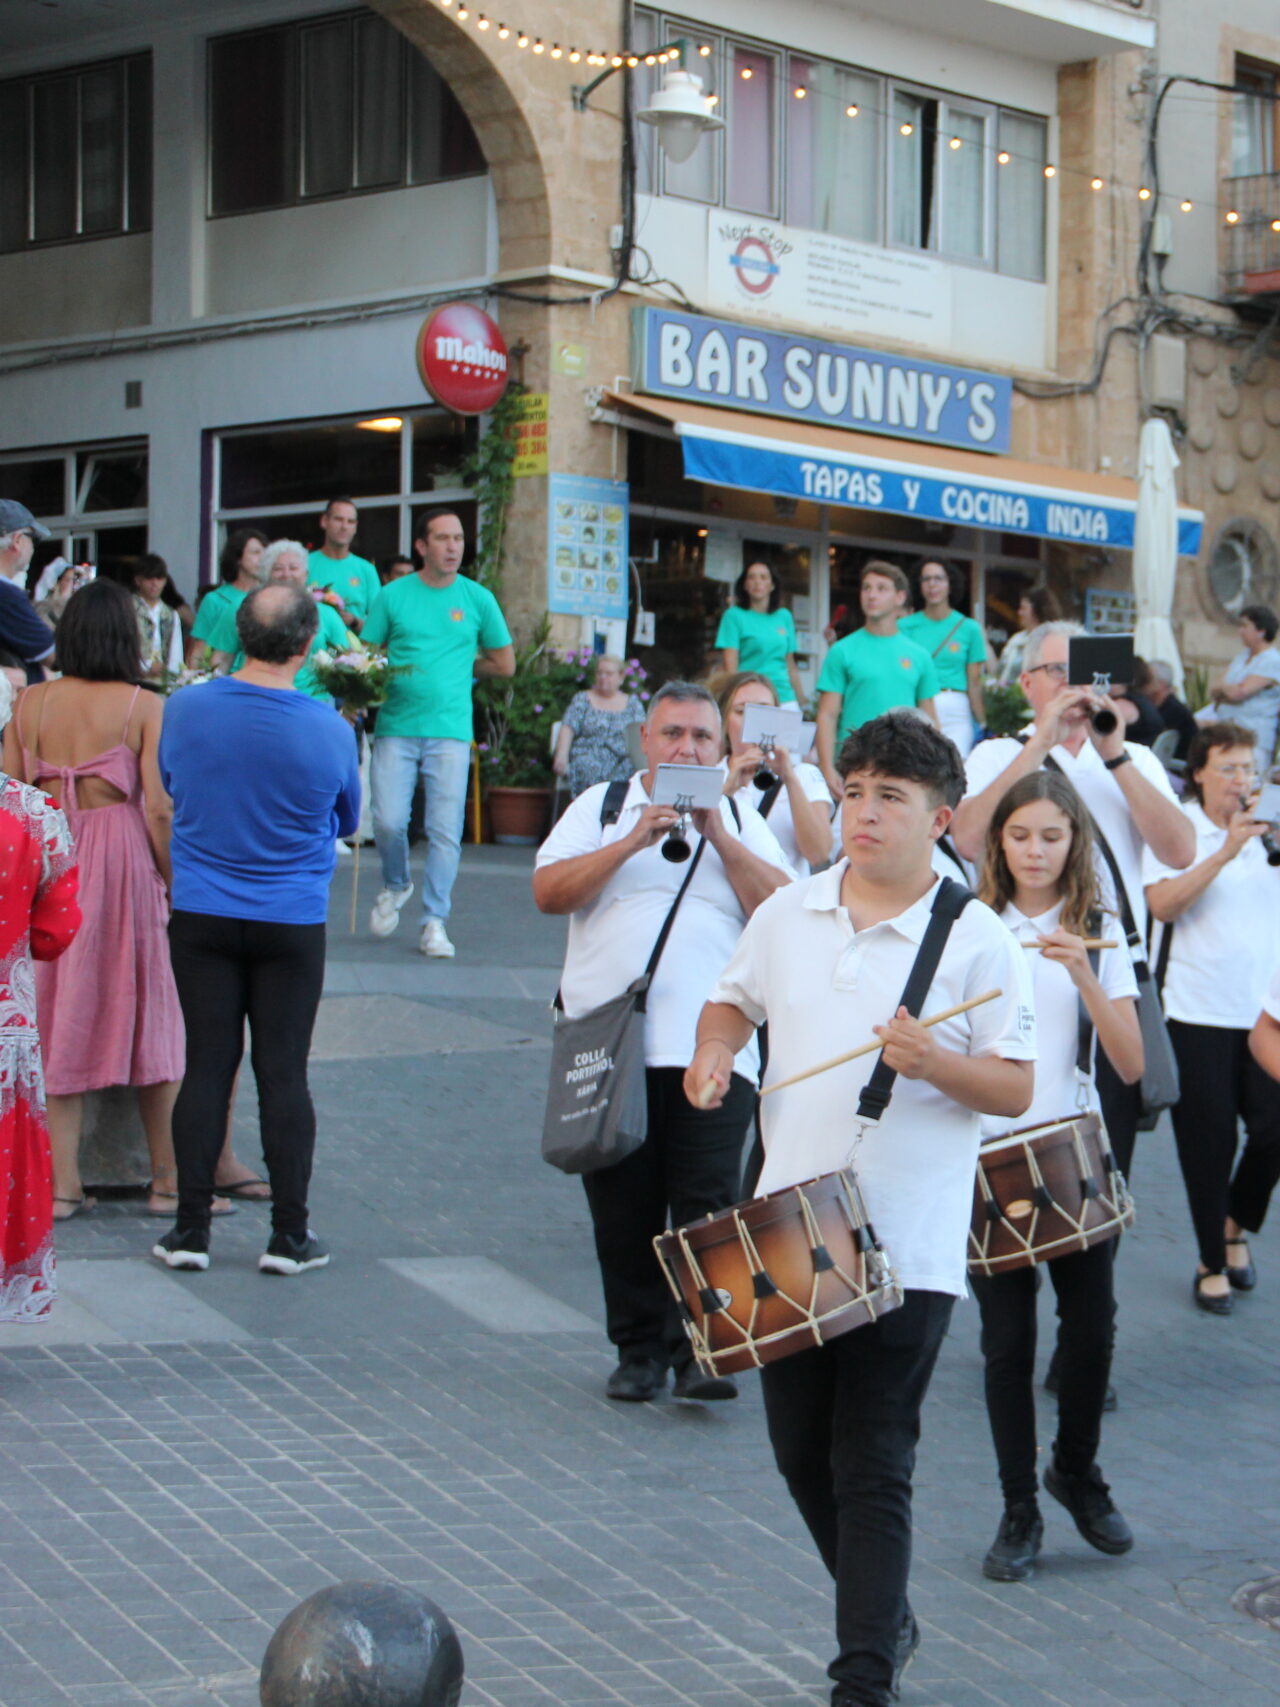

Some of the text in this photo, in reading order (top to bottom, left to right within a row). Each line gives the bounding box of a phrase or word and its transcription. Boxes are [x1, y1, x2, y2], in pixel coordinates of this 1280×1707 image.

[759, 227, 794, 257] Stop
[659, 321, 997, 443] BAR SUNNY'S
[800, 462, 1109, 541] TAPAS Y COCINA INDIA
